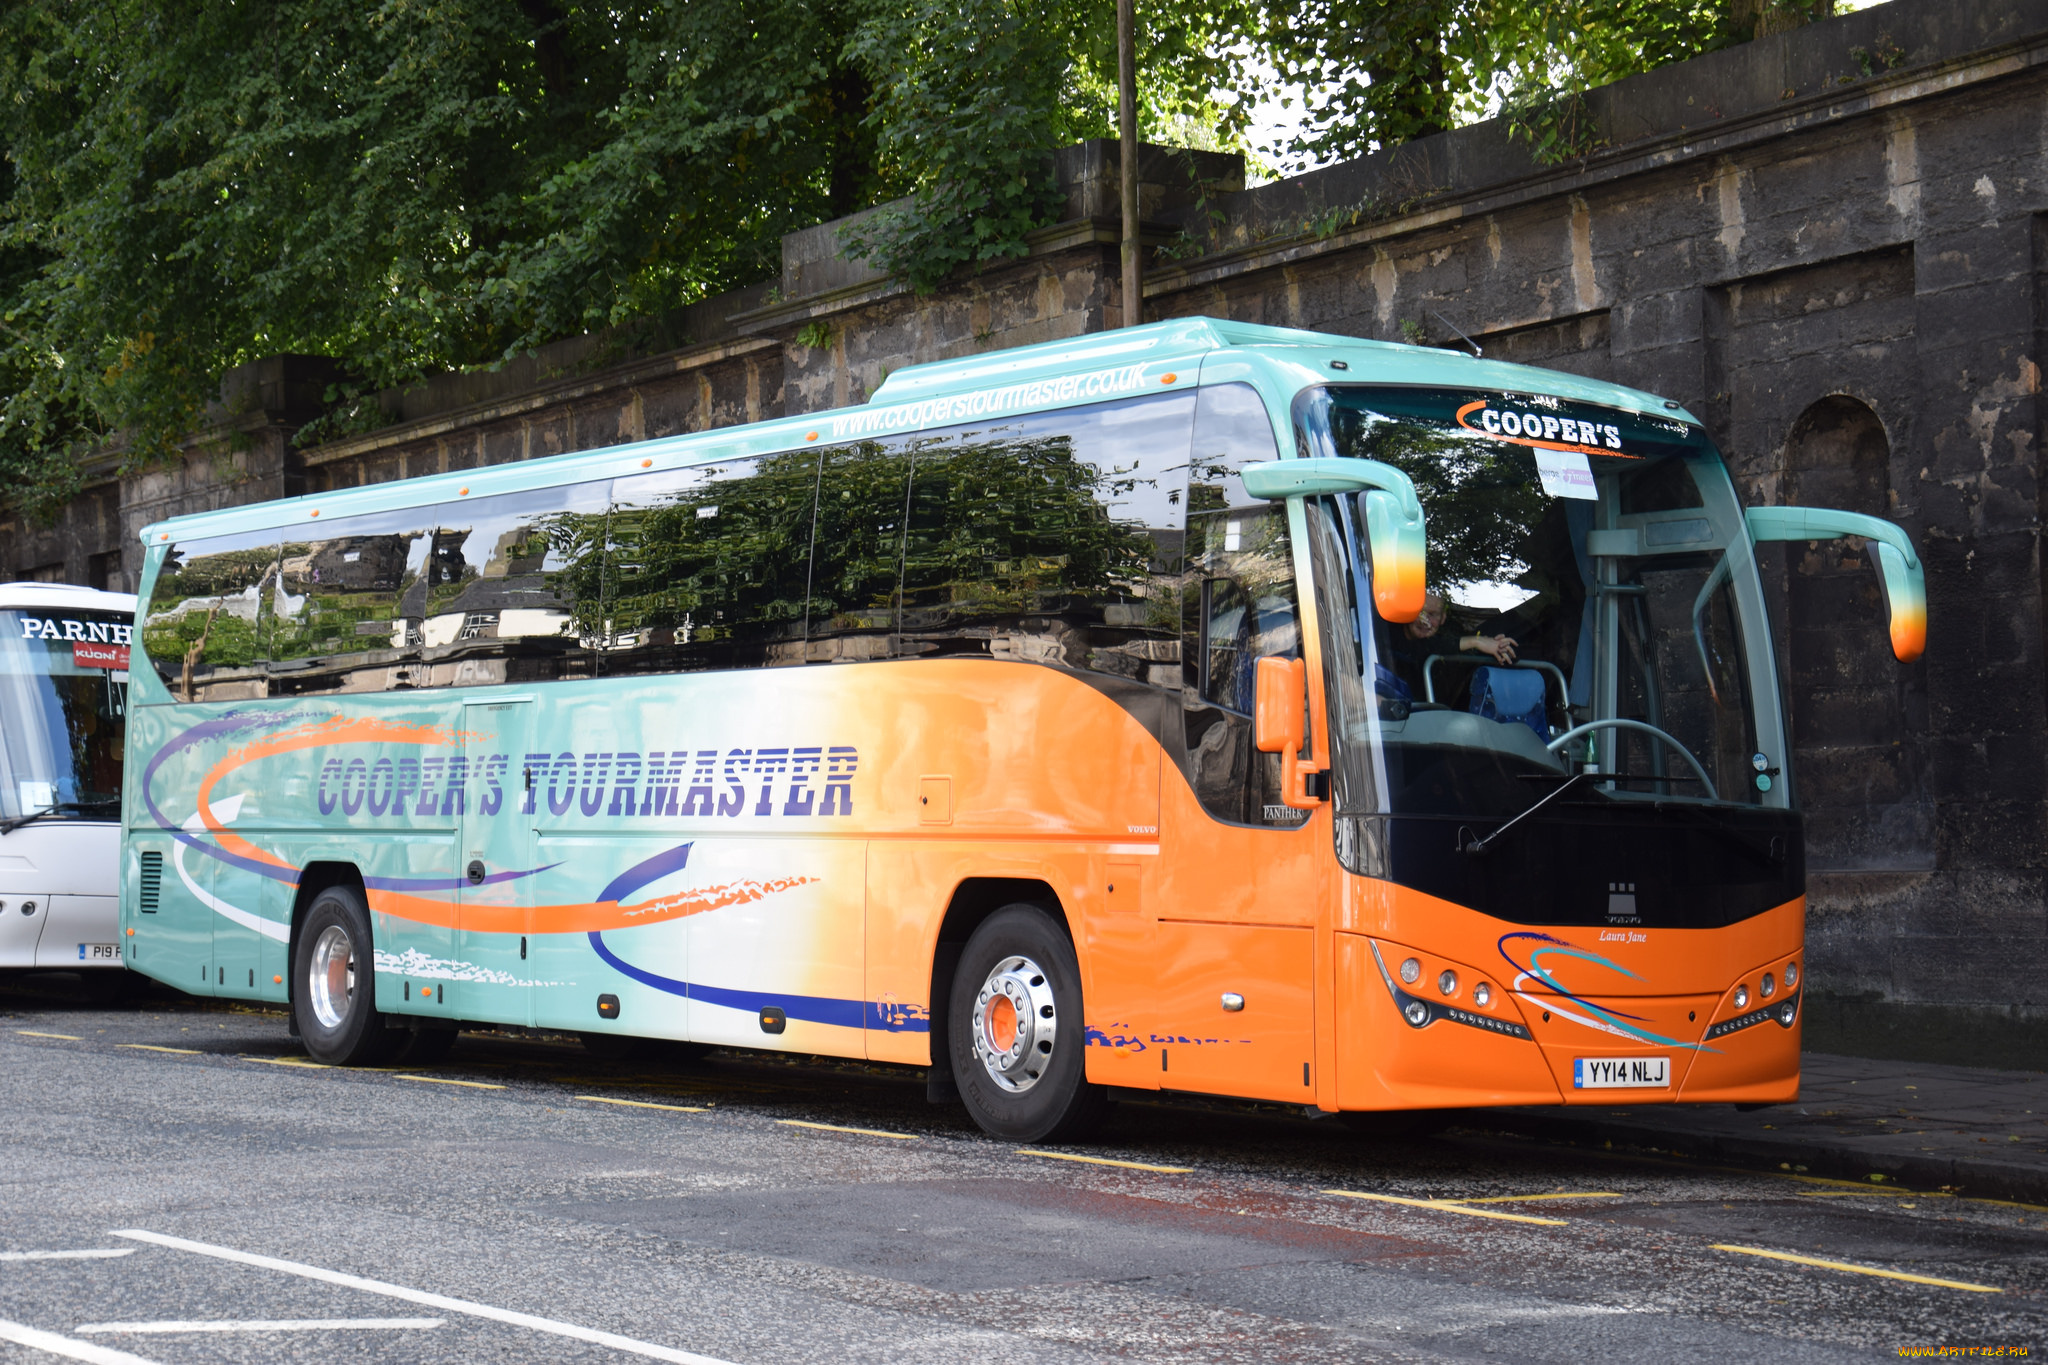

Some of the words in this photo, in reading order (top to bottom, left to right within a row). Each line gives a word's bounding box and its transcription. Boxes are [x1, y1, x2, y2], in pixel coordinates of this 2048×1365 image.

[832, 363, 1147, 437] www.cooperstourmaster.co.uk
[1482, 409, 1621, 449] COOPER'S
[318, 754, 509, 817] COOPER'S
[521, 746, 858, 818] TOURMASTER
[1127, 825, 1157, 834] VOLVO
[1599, 930, 1626, 941] Laura
[1626, 931, 1647, 943] Jane
[1590, 1061, 1627, 1083] YY14
[1632, 1061, 1664, 1083] NLJ
